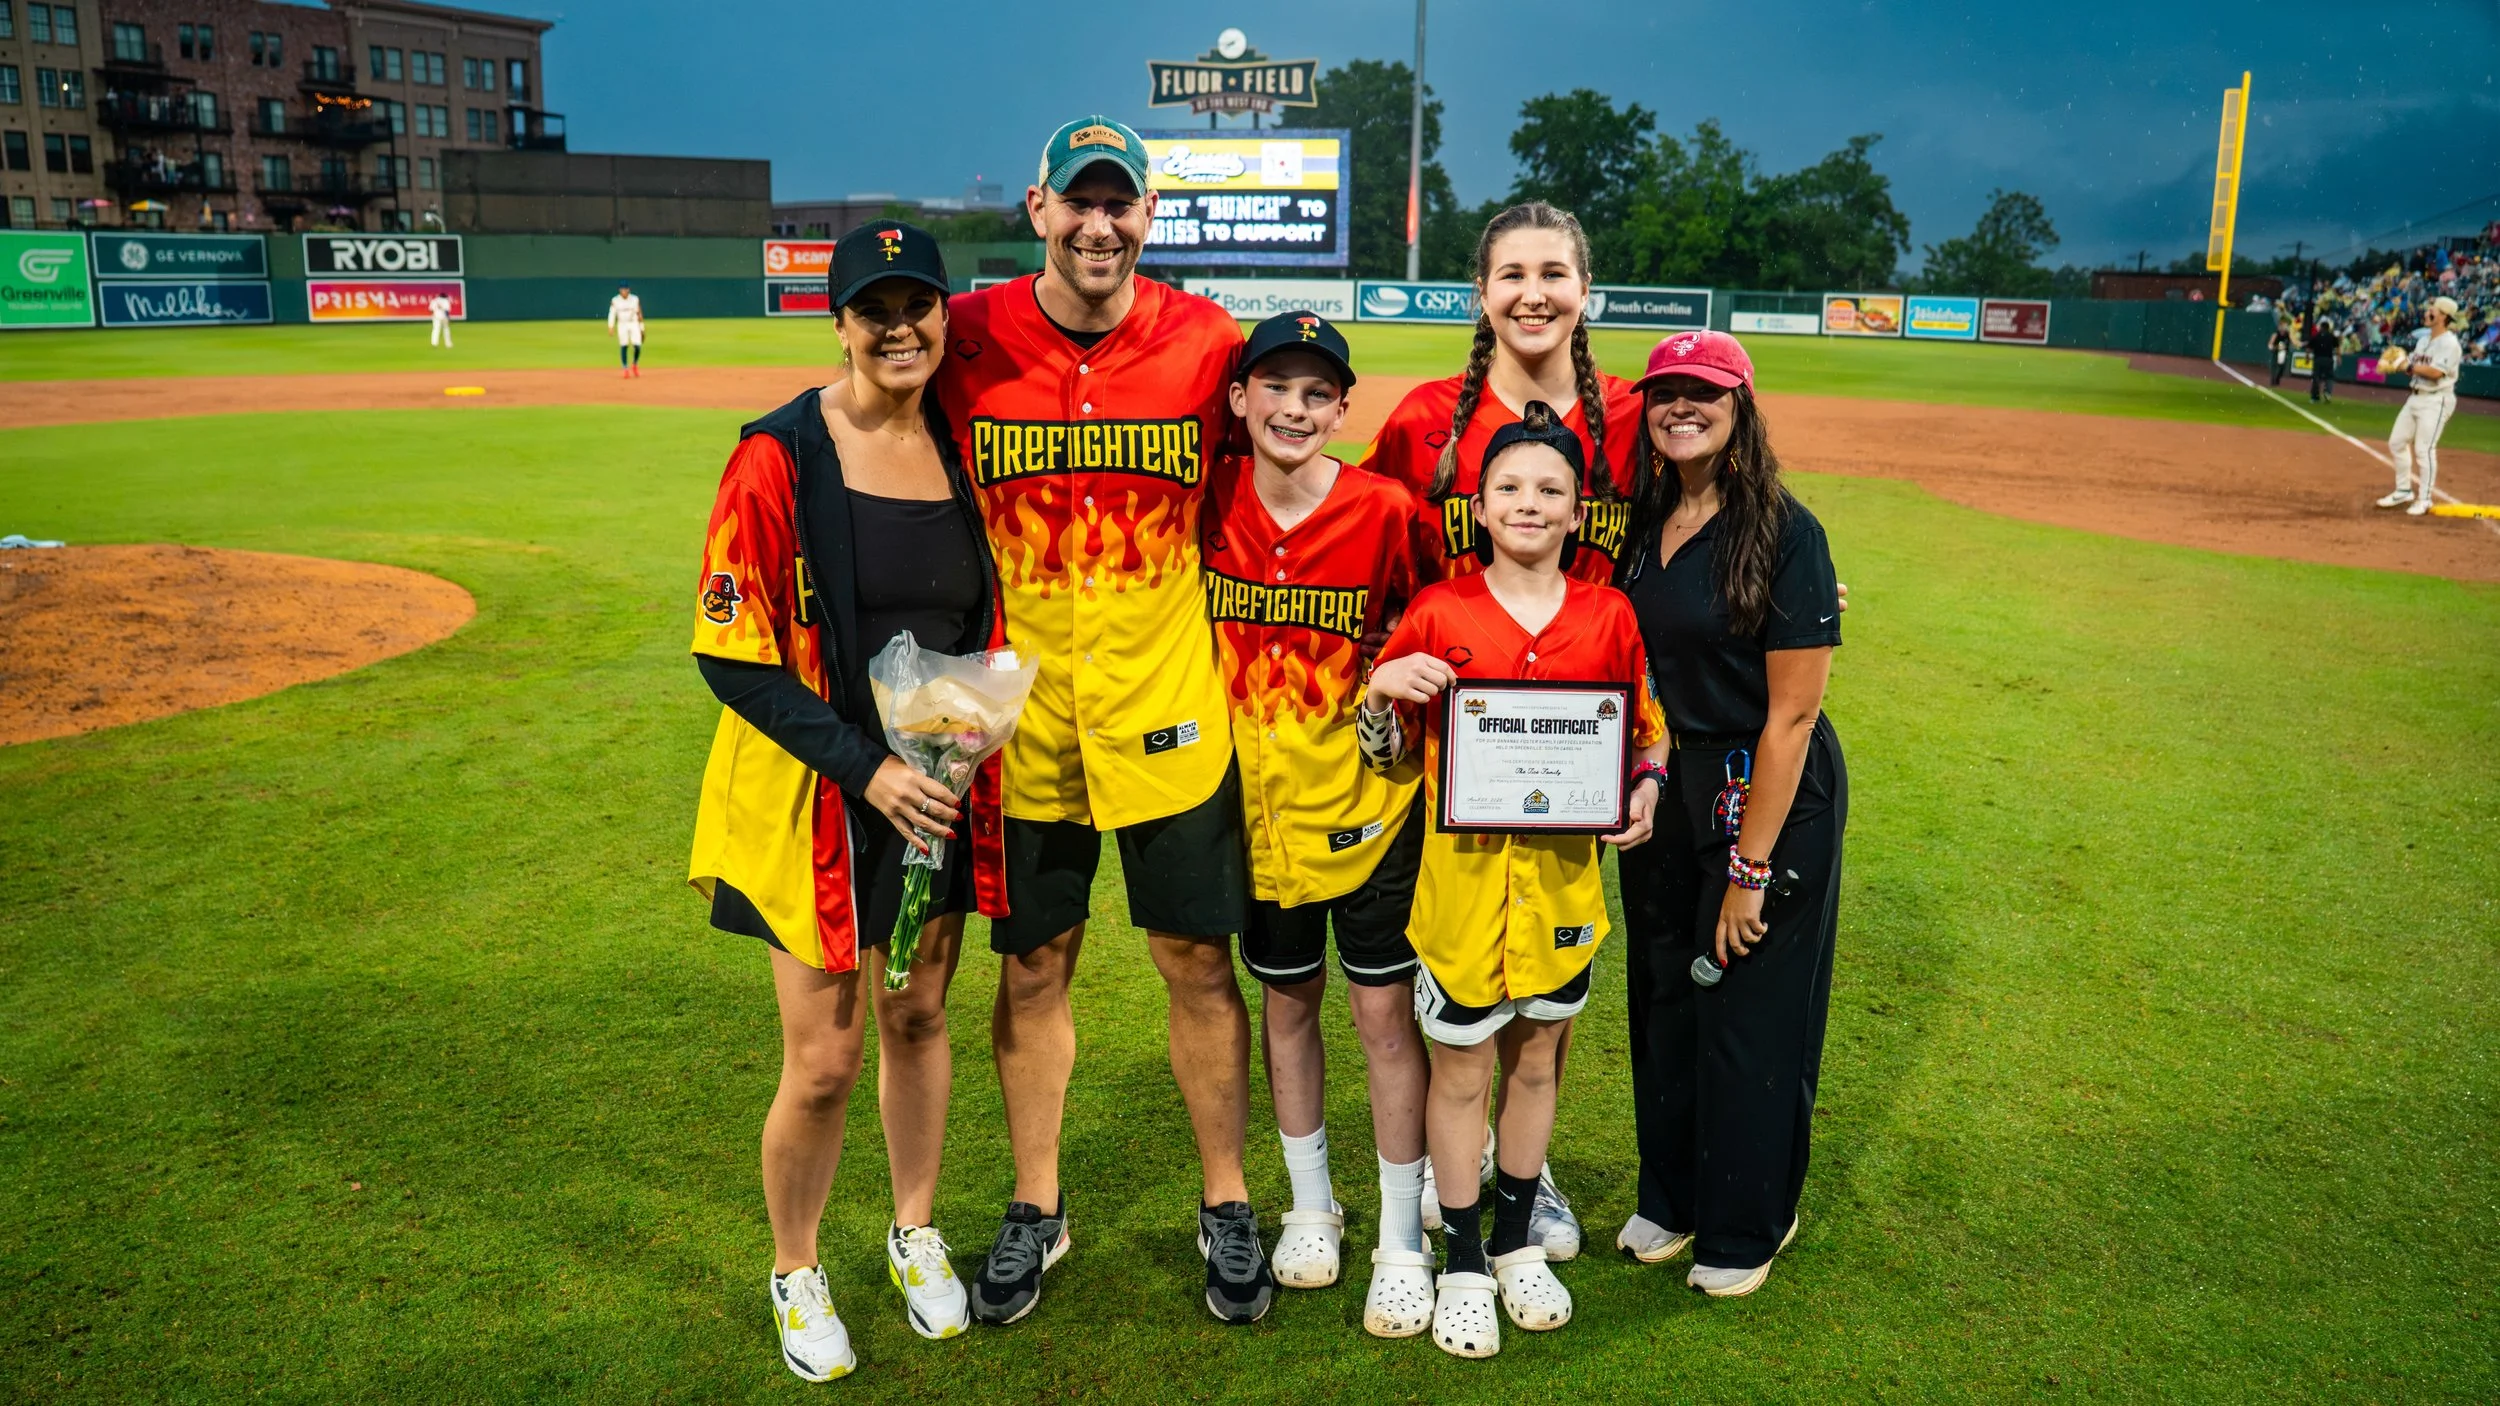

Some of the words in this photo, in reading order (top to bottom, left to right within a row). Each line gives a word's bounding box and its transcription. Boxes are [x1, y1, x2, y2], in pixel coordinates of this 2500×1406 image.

[1161, 69, 1223, 96] FLUOR
[1243, 67, 1304, 95] FIELD
[1153, 198, 1191, 217] EXT
[1297, 199, 1327, 218] TO
[1145, 219, 1200, 245] 0155
[1202, 223, 1231, 241] TO
[1232, 223, 1327, 242] SUPPORT
[156, 249, 175, 262] GE
[178, 250, 244, 262] VERNOVA
[330, 240, 440, 271] RYOBI
[1, 285, 85, 302] Greenville
[784, 285, 828, 293] PRIORIT
[124, 285, 248, 321] Milliken
[314, 291, 401, 310] PRISMA
[1224, 294, 1261, 311] Bon
[1266, 294, 1343, 313] Secours
[1607, 300, 1641, 313] South
[1643, 301, 1692, 316] Carolina
[974, 420, 1200, 484] FIREFIGHTERS
[724, 581, 731, 593] 3
[1479, 717, 1528, 733] OFFICIAL
[1531, 718, 1599, 735] CERTIFICATE
